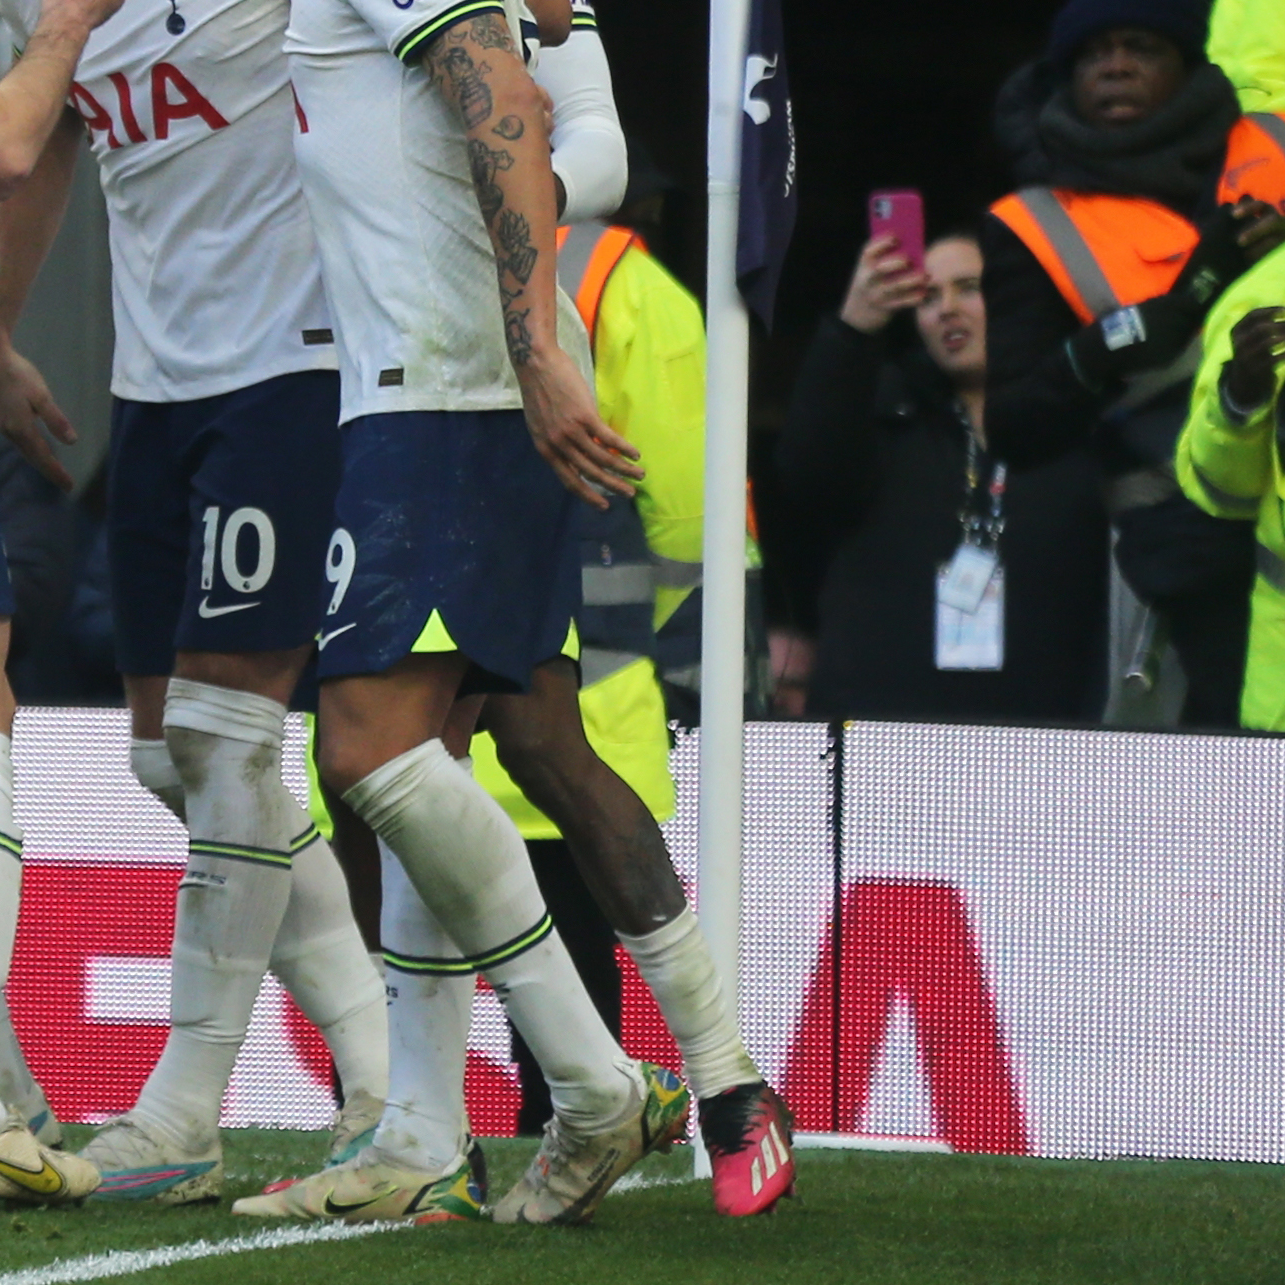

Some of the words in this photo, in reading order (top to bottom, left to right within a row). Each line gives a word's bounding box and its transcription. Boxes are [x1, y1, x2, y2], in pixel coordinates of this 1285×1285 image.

[70, 62, 231, 149] AIA
[200, 506, 276, 594] 10
[325, 527, 357, 615] 9
